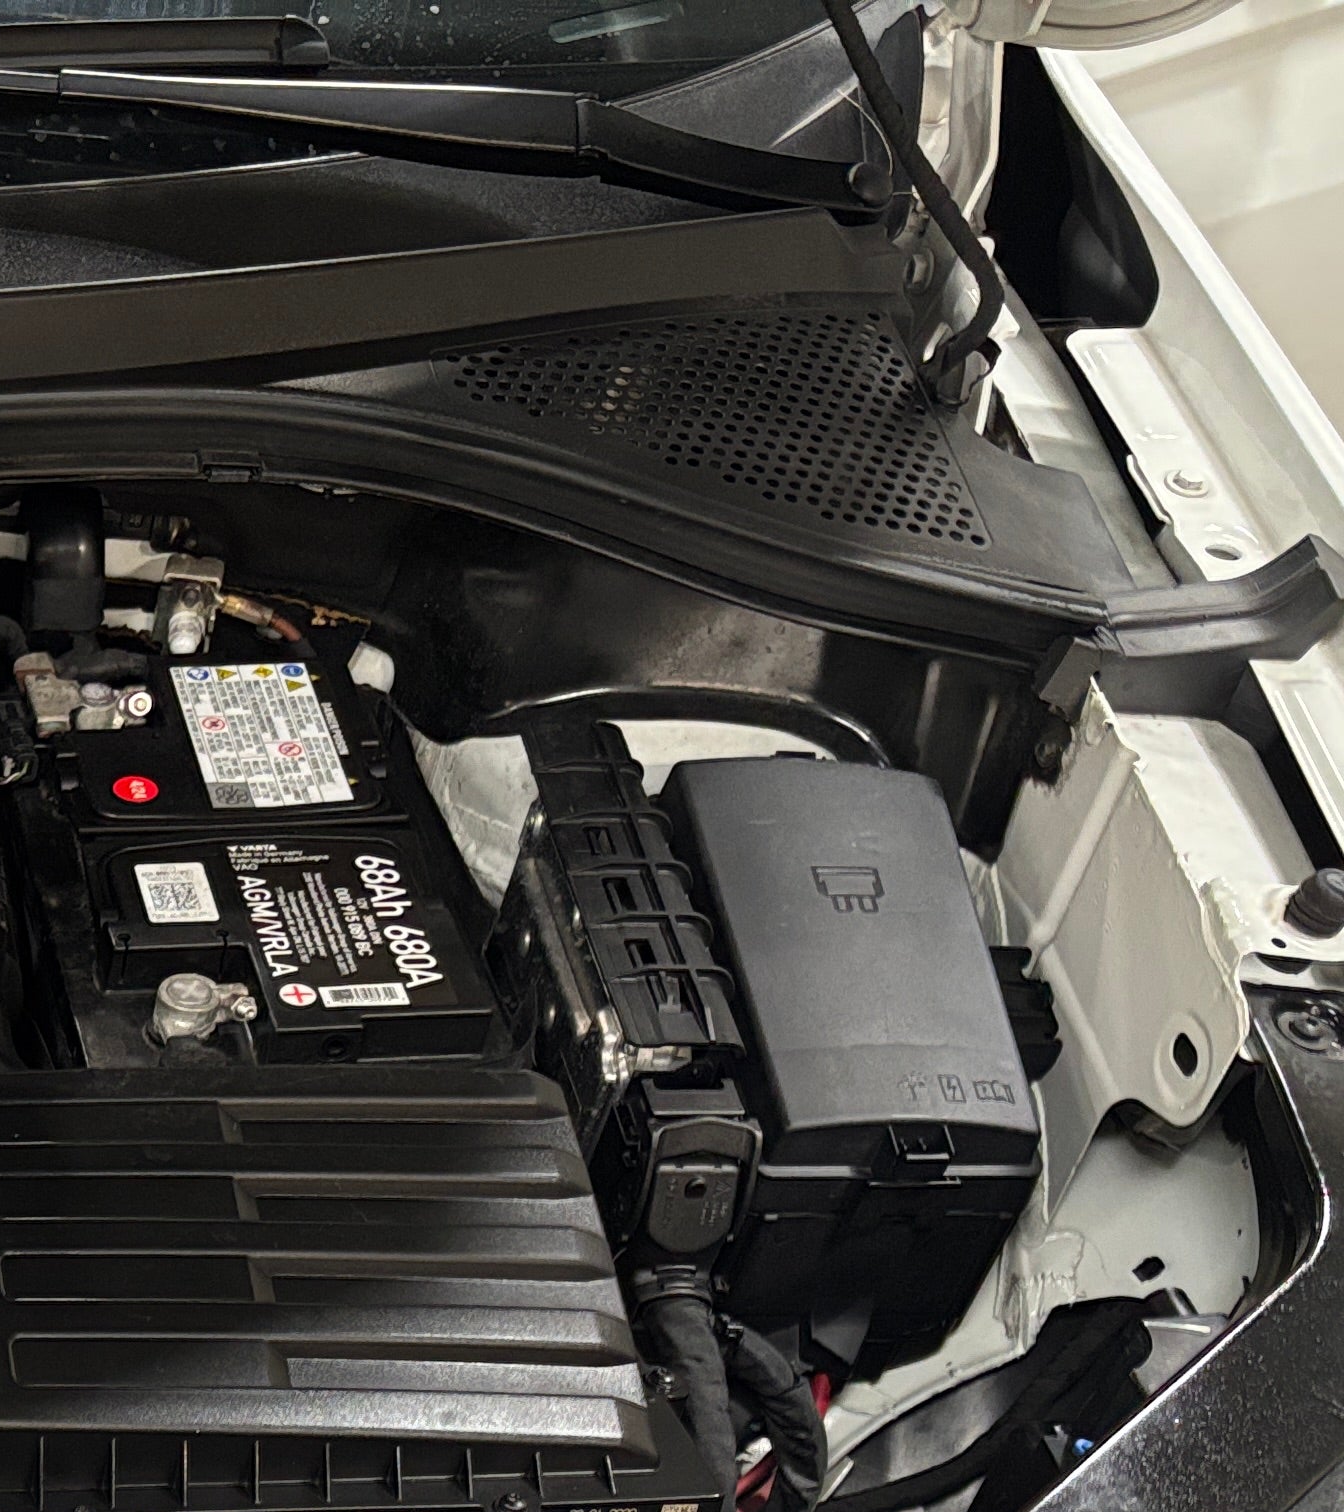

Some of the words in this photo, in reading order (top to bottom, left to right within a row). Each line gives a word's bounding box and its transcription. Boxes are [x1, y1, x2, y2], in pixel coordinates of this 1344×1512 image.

[283, 855, 329, 863] Allemagne
[355, 855, 412, 917] 68Ah
[237, 875, 299, 978] AGM/VRLA
[383, 925, 443, 989] 680A
